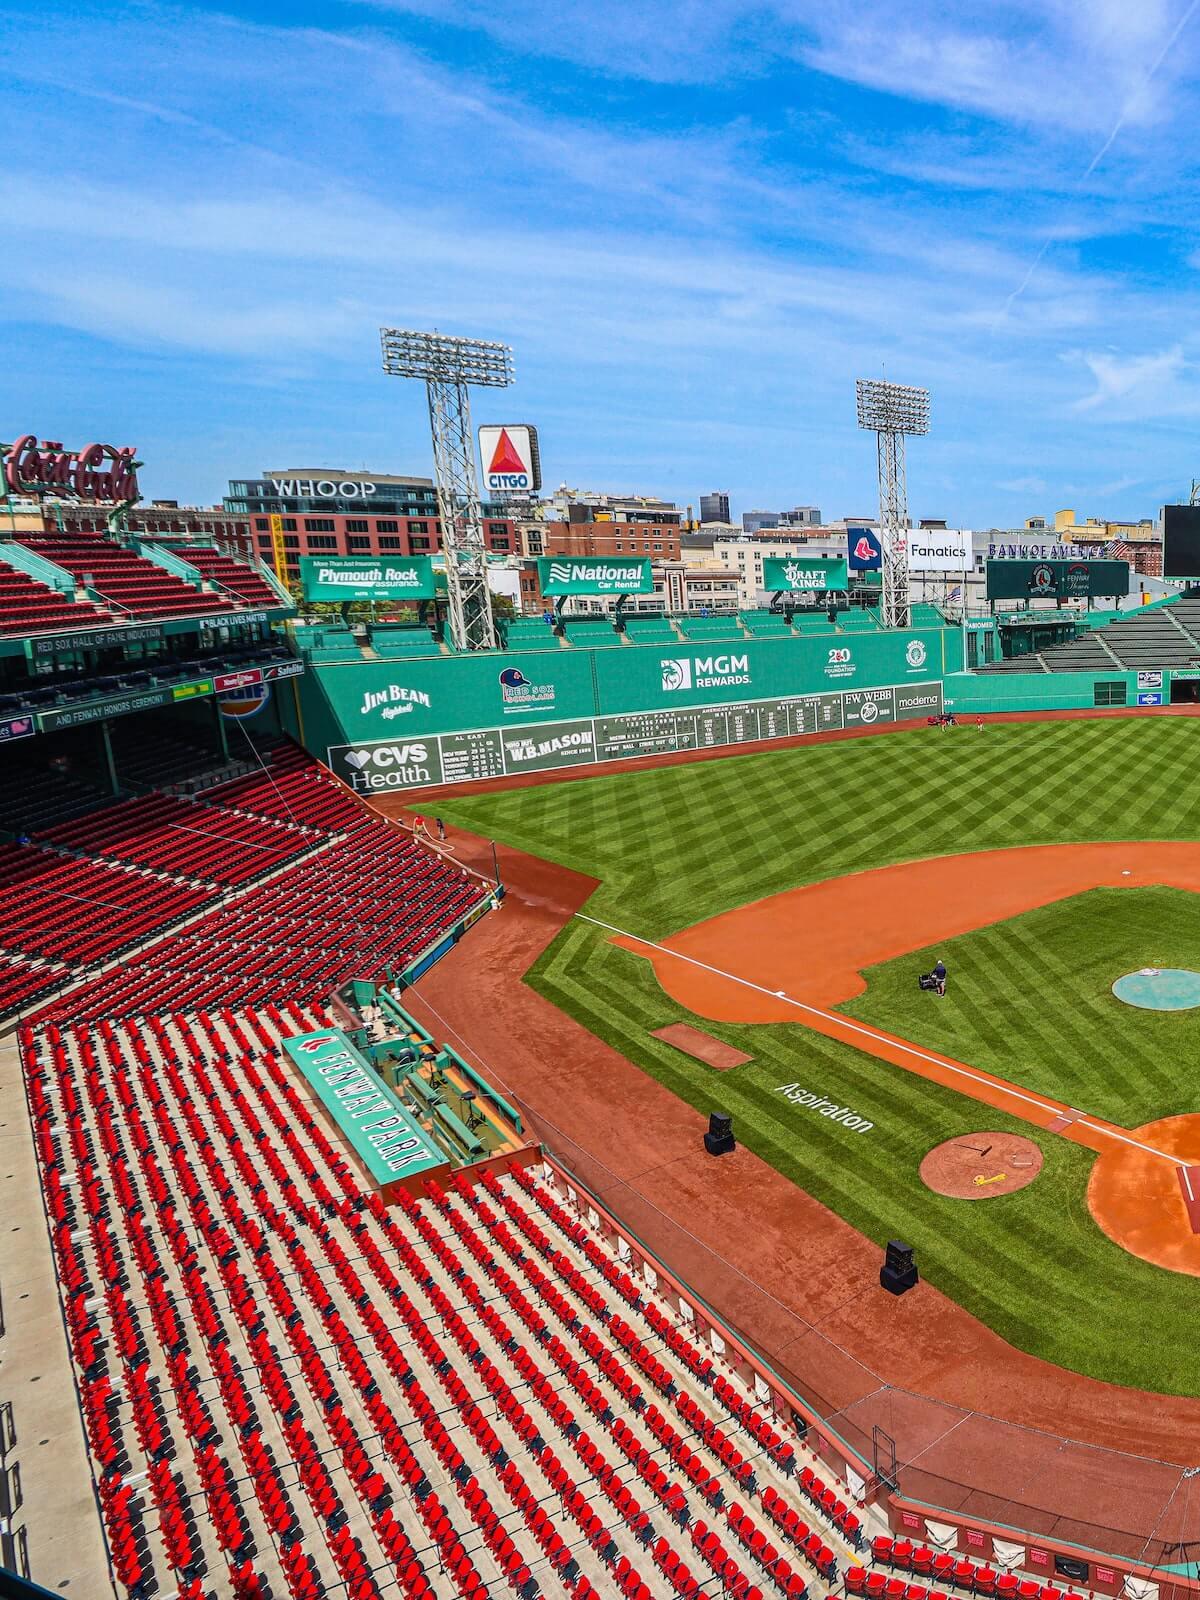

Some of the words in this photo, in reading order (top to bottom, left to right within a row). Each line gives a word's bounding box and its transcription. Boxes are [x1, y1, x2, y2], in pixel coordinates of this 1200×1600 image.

[489, 474, 528, 488] CITGO
[272, 479, 376, 499] WHOOP
[911, 543, 966, 558] Fanatics
[988, 543, 1029, 556] BANK
[1031, 544, 1046, 556] OF
[1050, 544, 1105, 557] AMERICA
[318, 568, 382, 583] Plymouth
[386, 568, 417, 581] Rock
[786, 570, 827, 582] DRAFT
[598, 581, 612, 589] Car
[615, 581, 640, 589] Rental
[791, 579, 826, 588] KINGS
[209, 619, 229, 628] BLACK
[230, 616, 245, 625] LIVES
[246, 613, 267, 623] MATTER
[37, 641, 53, 652] RED
[55, 639, 71, 650] SOX
[72, 637, 94, 648] HALL
[95, 635, 106, 645] OF
[107, 631, 126, 643] FAME
[127, 628, 160, 641] INDUCTION
[694, 654, 749, 676] MGM
[507, 687, 529, 697] RED
[532, 684, 555, 694] SOX
[863, 690, 892, 702] WEBB
[361, 690, 388, 714] JIM
[389, 684, 432, 708] BEAM
[899, 694, 938, 708] moderna
[56, 714, 72, 726] AND
[73, 708, 102, 723] FENWAY
[104, 702, 130, 715] HONORS
[131, 694, 164, 709] CEREMONY
[702, 706, 728, 714] AMERICAN
[614, 715, 649, 723] FENWAY
[510, 731, 593, 762] W.B.MASON
[560, 749, 578, 757] SINCE
[372, 743, 428, 767] CVS
[350, 764, 431, 790] Health
[311, 1051, 393, 1119] FENWAY
[360, 1115, 433, 1173] PARK
[774, 1082, 874, 1133] Aspiration
